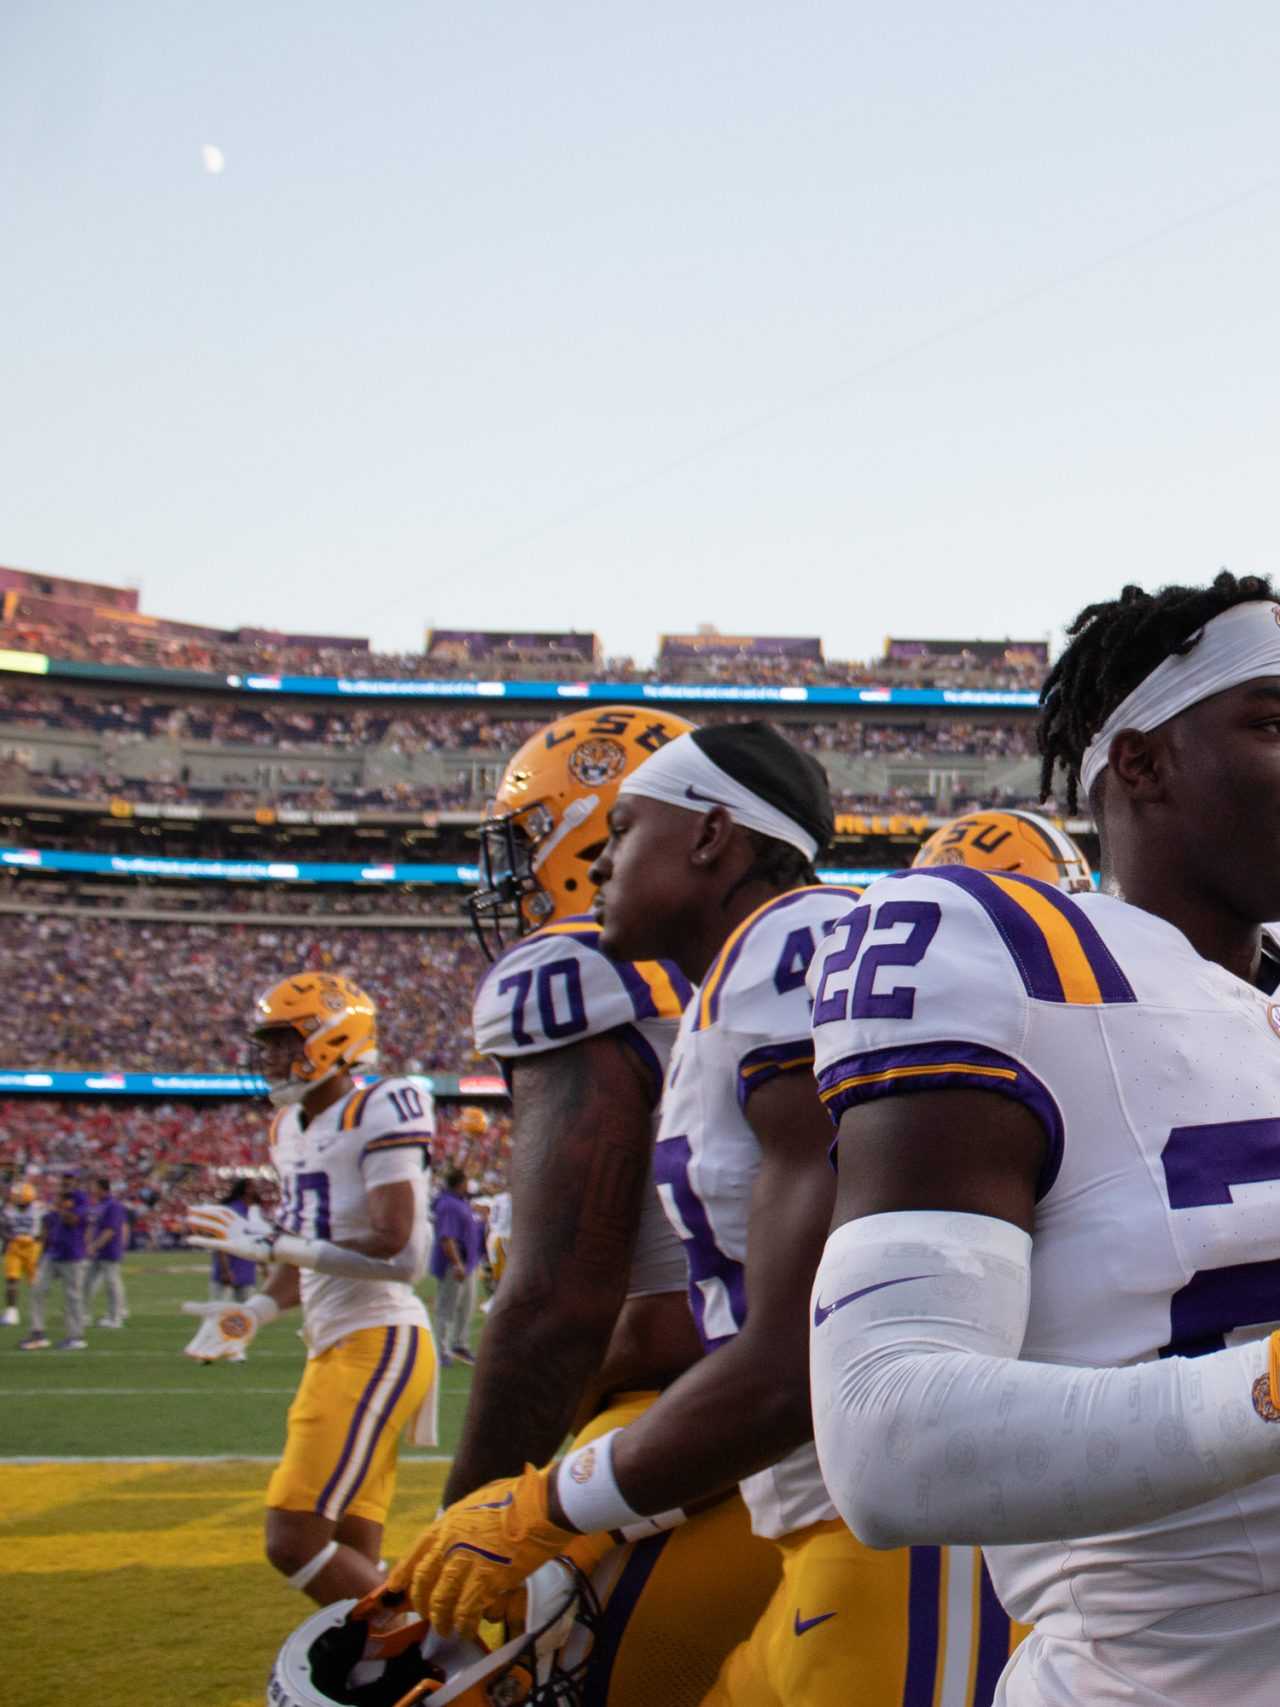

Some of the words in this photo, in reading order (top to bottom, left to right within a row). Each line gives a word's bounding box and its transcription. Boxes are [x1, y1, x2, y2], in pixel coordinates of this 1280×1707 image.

[498, 957, 588, 1047] 70
[812, 900, 942, 1028] 22
[388, 1087, 424, 1122] 10
